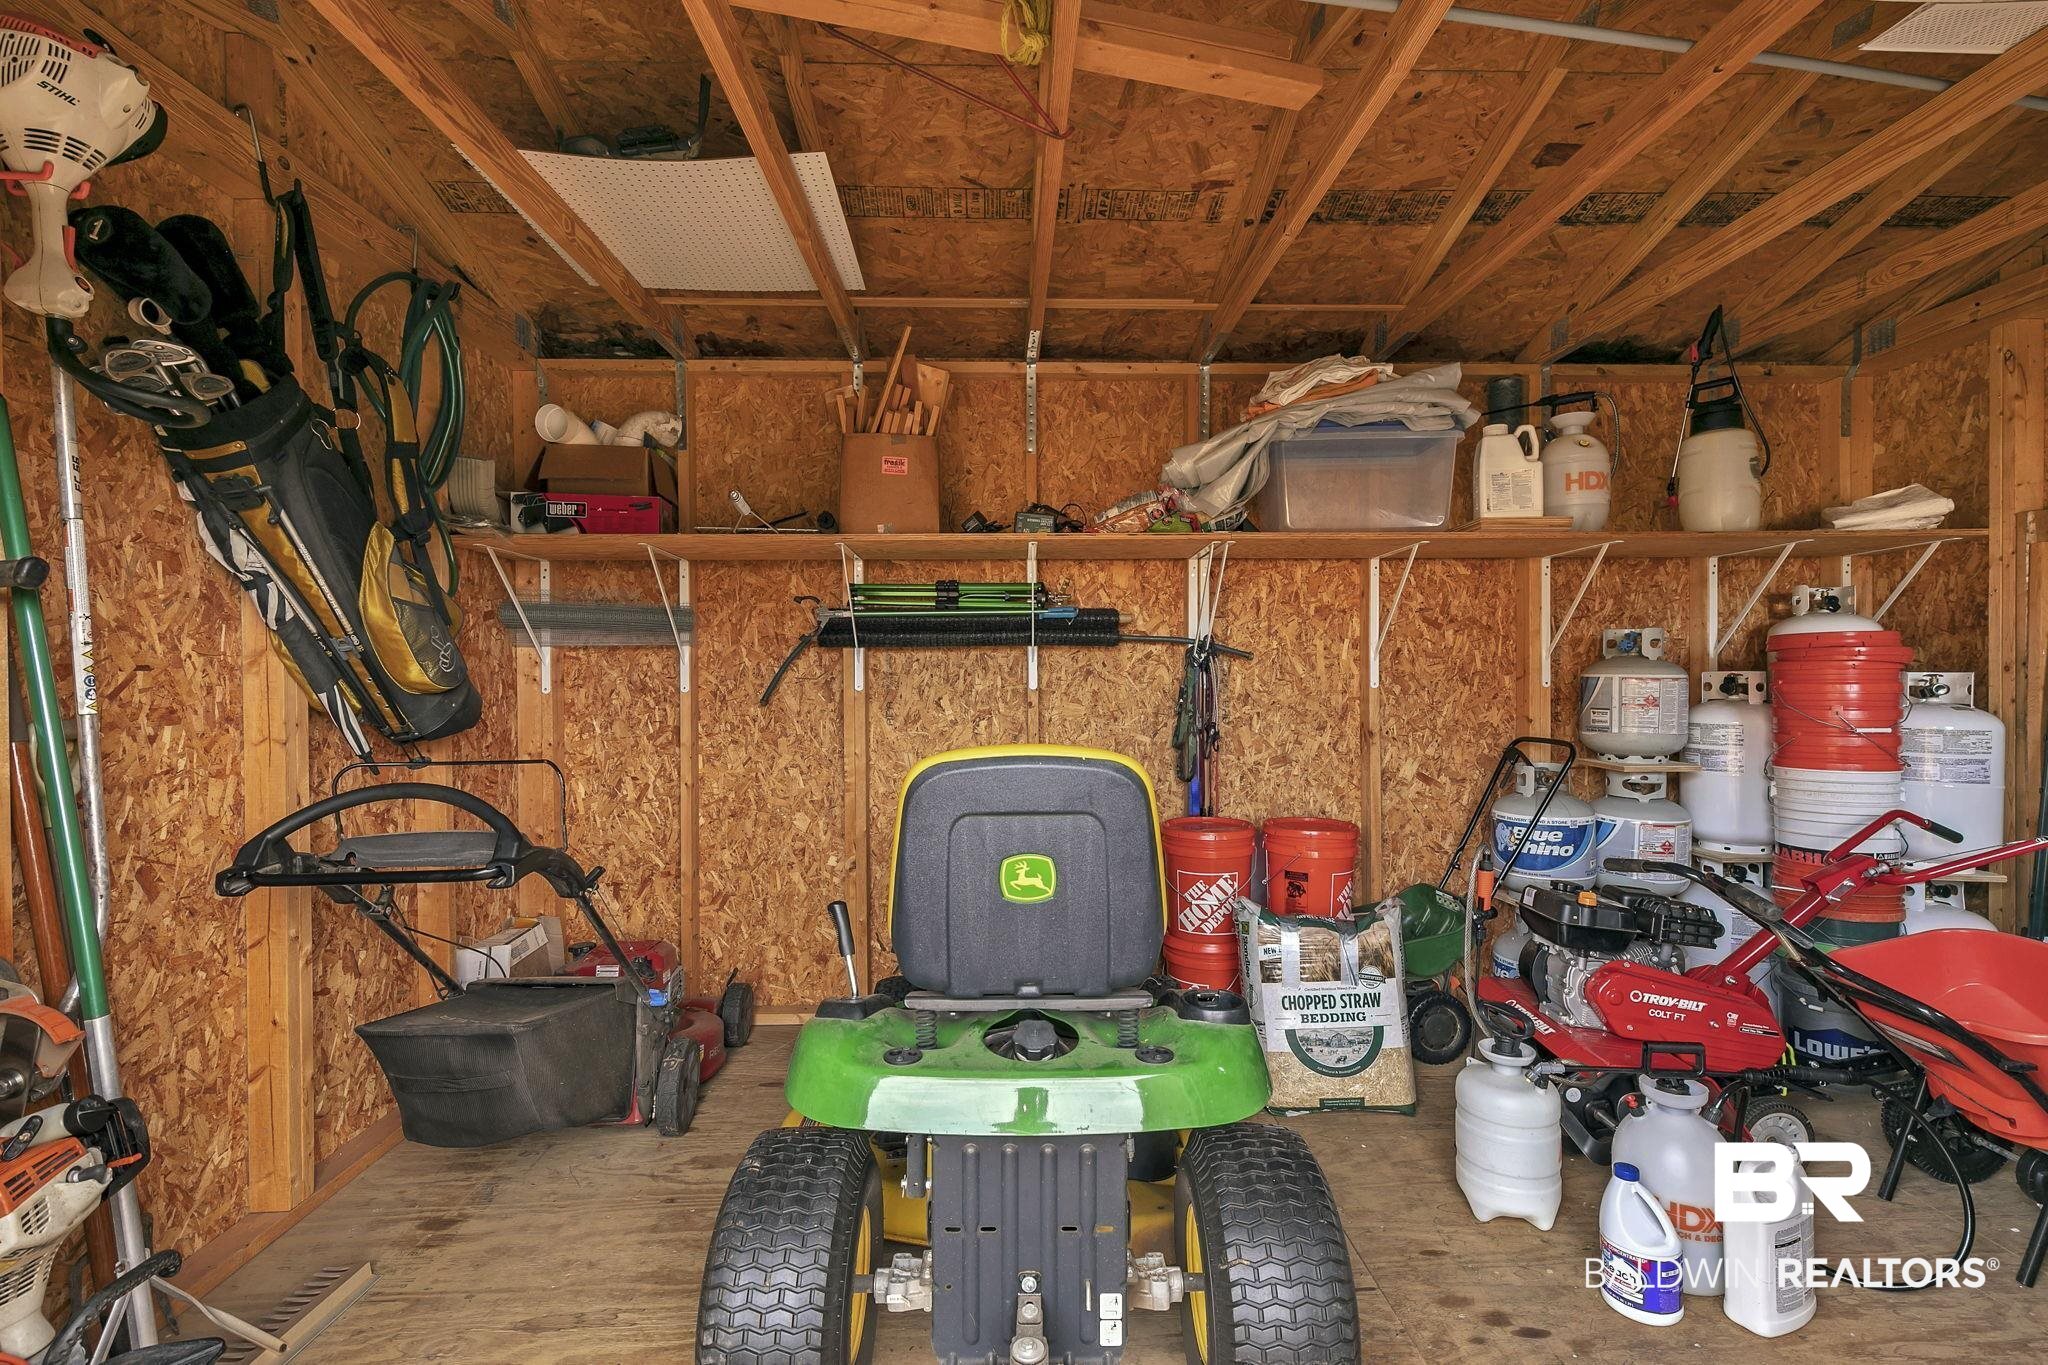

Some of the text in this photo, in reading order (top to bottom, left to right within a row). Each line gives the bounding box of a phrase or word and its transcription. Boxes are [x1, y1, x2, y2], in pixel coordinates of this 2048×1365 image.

[36, 80, 77, 106] STIHL
[88, 219, 104, 241] 1
[549, 501, 578, 516] weber
[1507, 841, 1575, 857] hino
[1183, 880, 1210, 903] THE
[1179, 873, 1238, 933] HOME
[1263, 946, 1277, 956] NEW
[1281, 992, 1381, 1011] CHOPPED STRAW
[1642, 992, 1708, 1012] TROY-BILT
[1300, 1011, 1367, 1024] BEDDING
[1648, 1008, 1687, 1022] COLT FT
